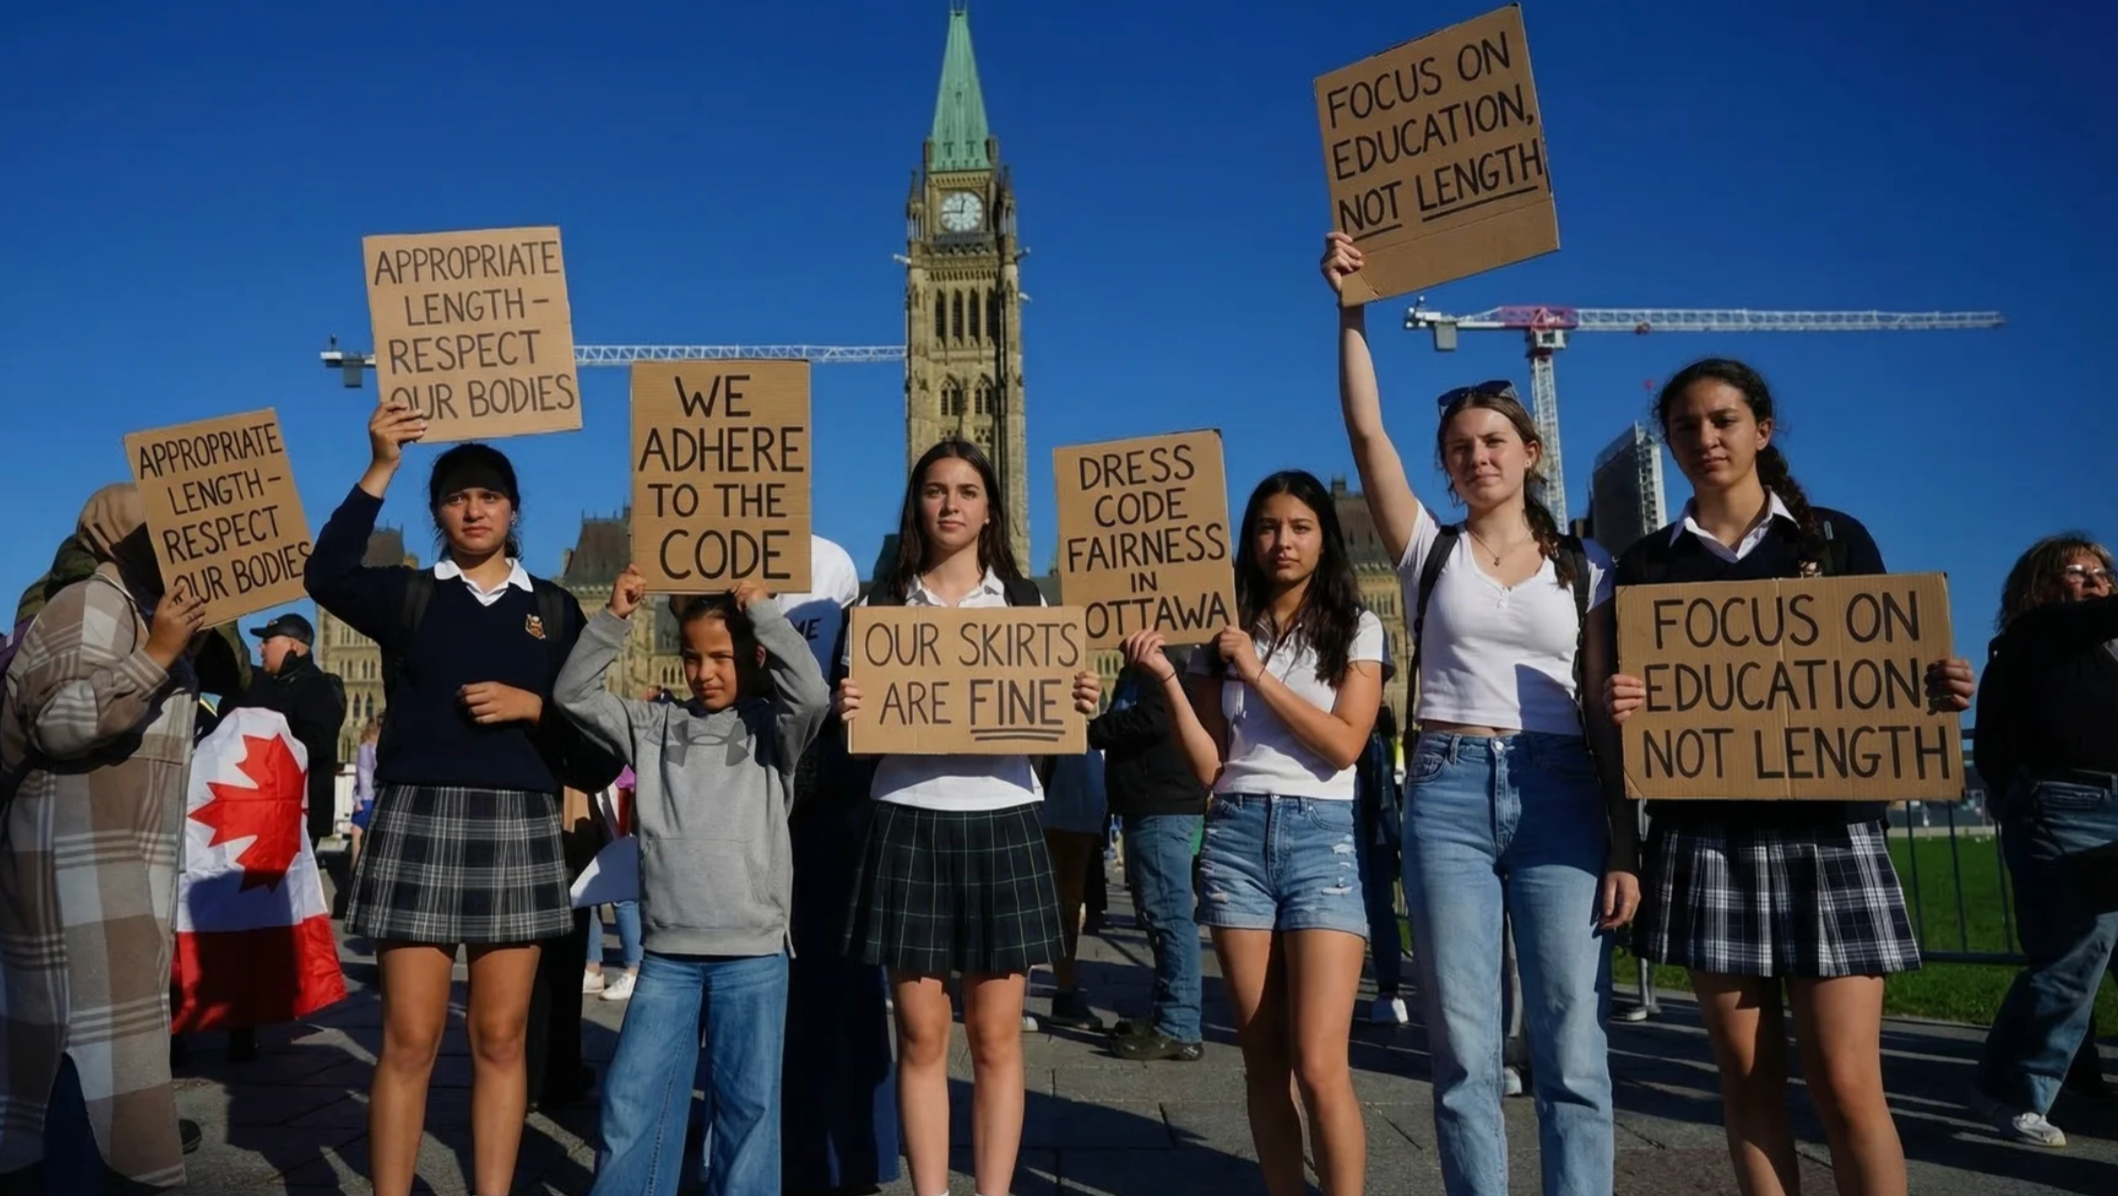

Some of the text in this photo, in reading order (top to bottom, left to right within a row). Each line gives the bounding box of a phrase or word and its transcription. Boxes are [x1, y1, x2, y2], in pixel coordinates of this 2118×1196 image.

[1327, 31, 1510, 129] FOCUS ON
[1332, 84, 1534, 180] EDUCATION,
[1339, 138, 1542, 233] NOT LENGTH
[374, 241, 559, 286] APPROPRIATE
[388, 330, 541, 374] RESPECT
[390, 373, 575, 420] OUR BODIES
[674, 374, 751, 418] WE
[140, 423, 283, 480] APPROPRIATE
[638, 427, 804, 472] ADHERE
[1079, 444, 1194, 491] DRESS
[648, 483, 787, 518] TO THE
[1094, 487, 1188, 528] CODE
[162, 506, 279, 564] RESPECT
[660, 529, 791, 580] CODE
[1068, 523, 1225, 572] FAIRNESS
[1131, 572, 1157, 593] IN
[1086, 591, 1230, 640] OTTAWA
[1653, 591, 1919, 649] FOCUS ON
[865, 622, 1079, 668] OUR SKIRTS
[879, 679, 1063, 725] ARE FINE
[1643, 726, 1950, 780] NOT LENGTH
